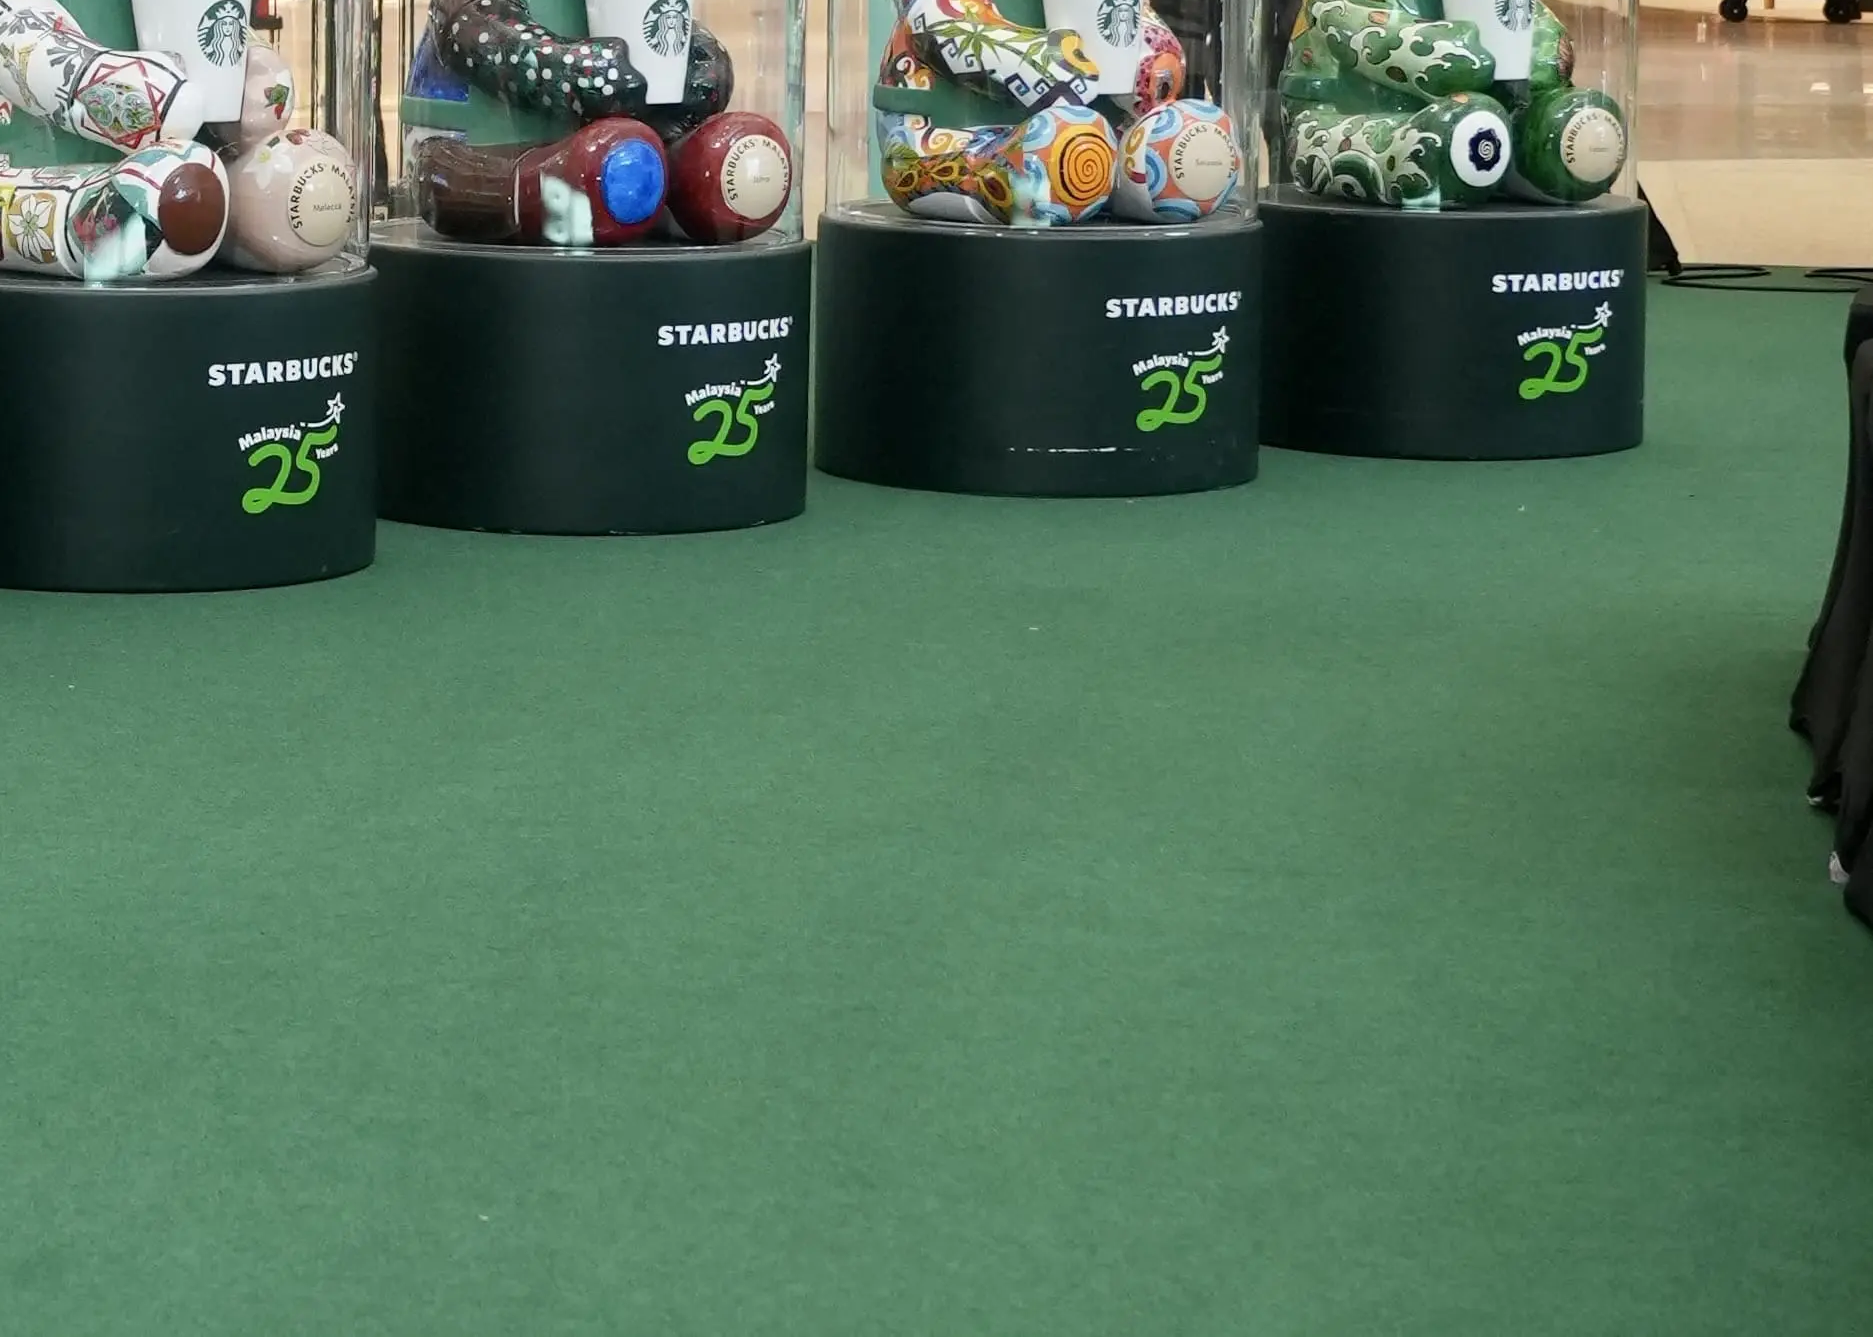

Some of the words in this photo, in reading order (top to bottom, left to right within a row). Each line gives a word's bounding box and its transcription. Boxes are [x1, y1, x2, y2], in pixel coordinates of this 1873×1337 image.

[1174, 124, 1208, 180] STARBUCKS
[290, 162, 325, 229] STARBUCKS
[1492, 269, 1621, 293] STARBUCKS
[1106, 290, 1239, 319] STARBUCKS
[657, 316, 790, 346] STARBUCKS
[1516, 325, 1573, 346] Malaysia
[208, 352, 355, 387] STARBUCKS
[1132, 352, 1190, 376] Malaysia
[1518, 326, 1604, 400] 25
[684, 381, 742, 407] Malaysia
[1136, 353, 1223, 432] 25
[238, 424, 302, 452] Malaysia
[687, 381, 774, 465] 25
[753, 400, 776, 415] Years
[242, 424, 338, 514] 25
[315, 442, 339, 460] Years
